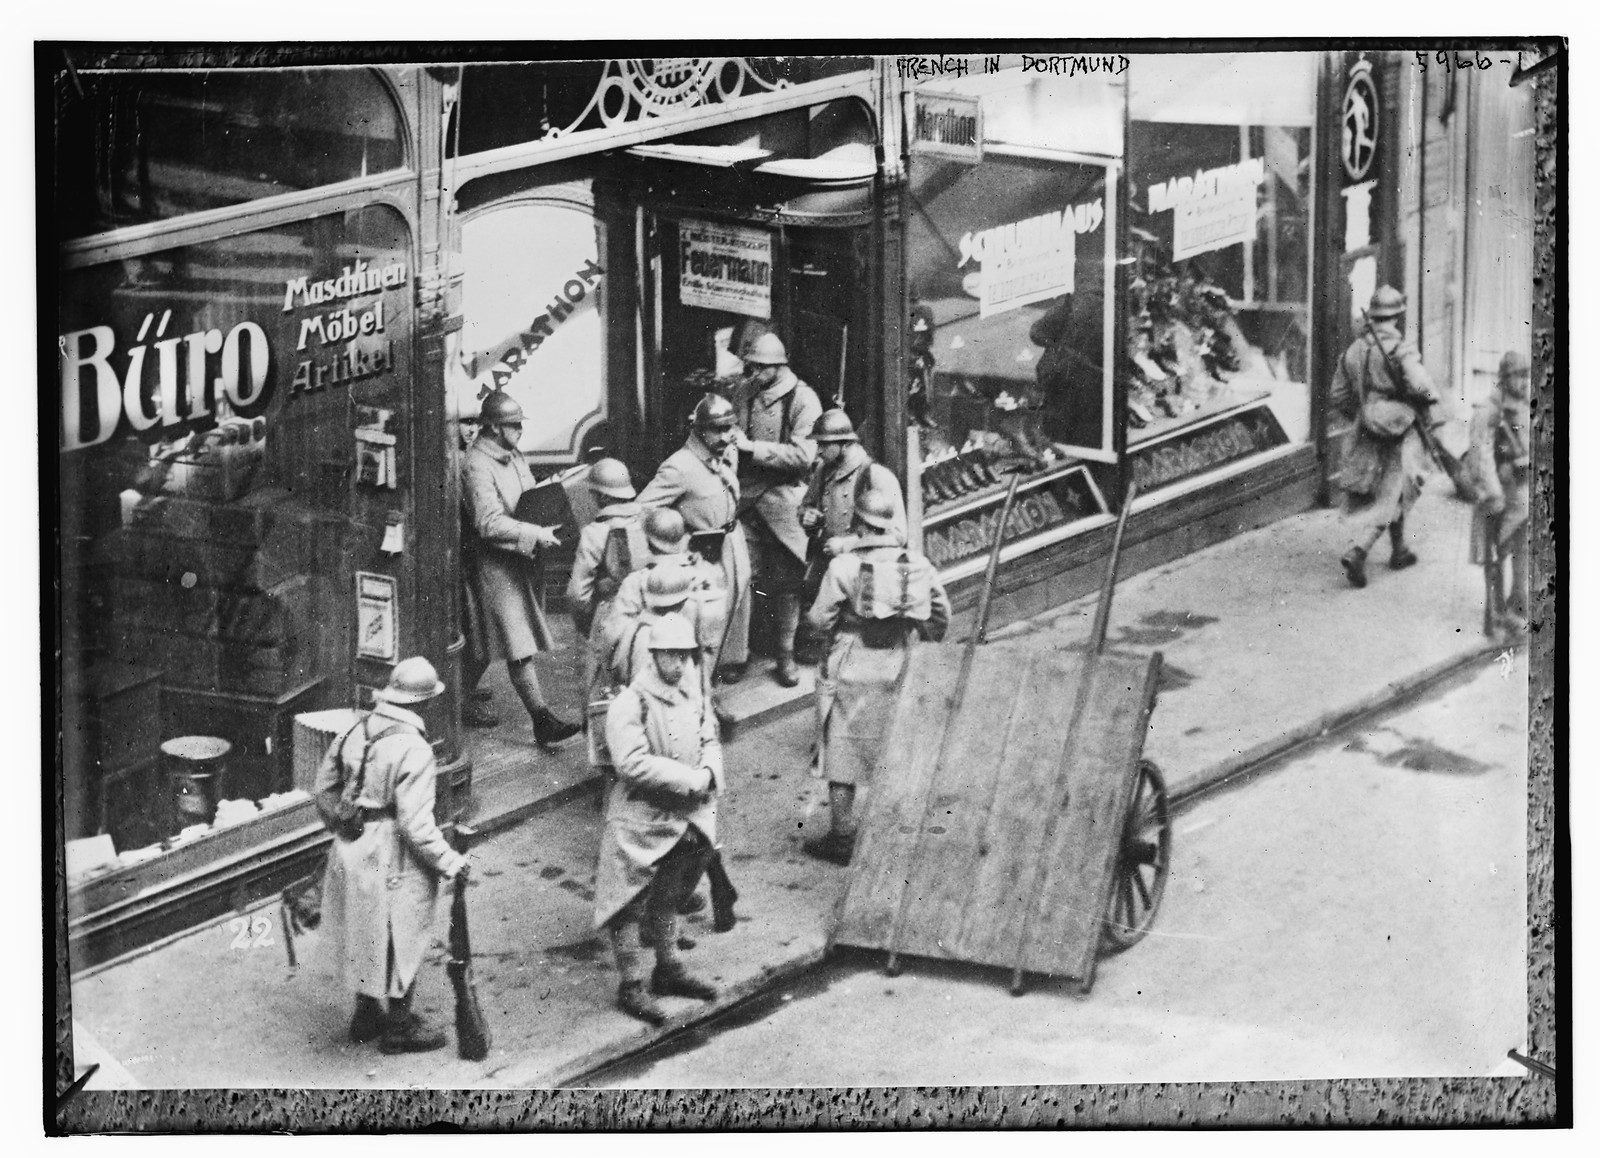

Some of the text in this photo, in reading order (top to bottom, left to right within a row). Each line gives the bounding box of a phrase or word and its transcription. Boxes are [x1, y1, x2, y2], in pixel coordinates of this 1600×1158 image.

[915, 103, 976, 147] Marathon
[281, 258, 407, 312] Maschinen
[296, 300, 385, 351] Möbel
[61, 308, 270, 452] Büro
[289, 340, 394, 394] Artikel
